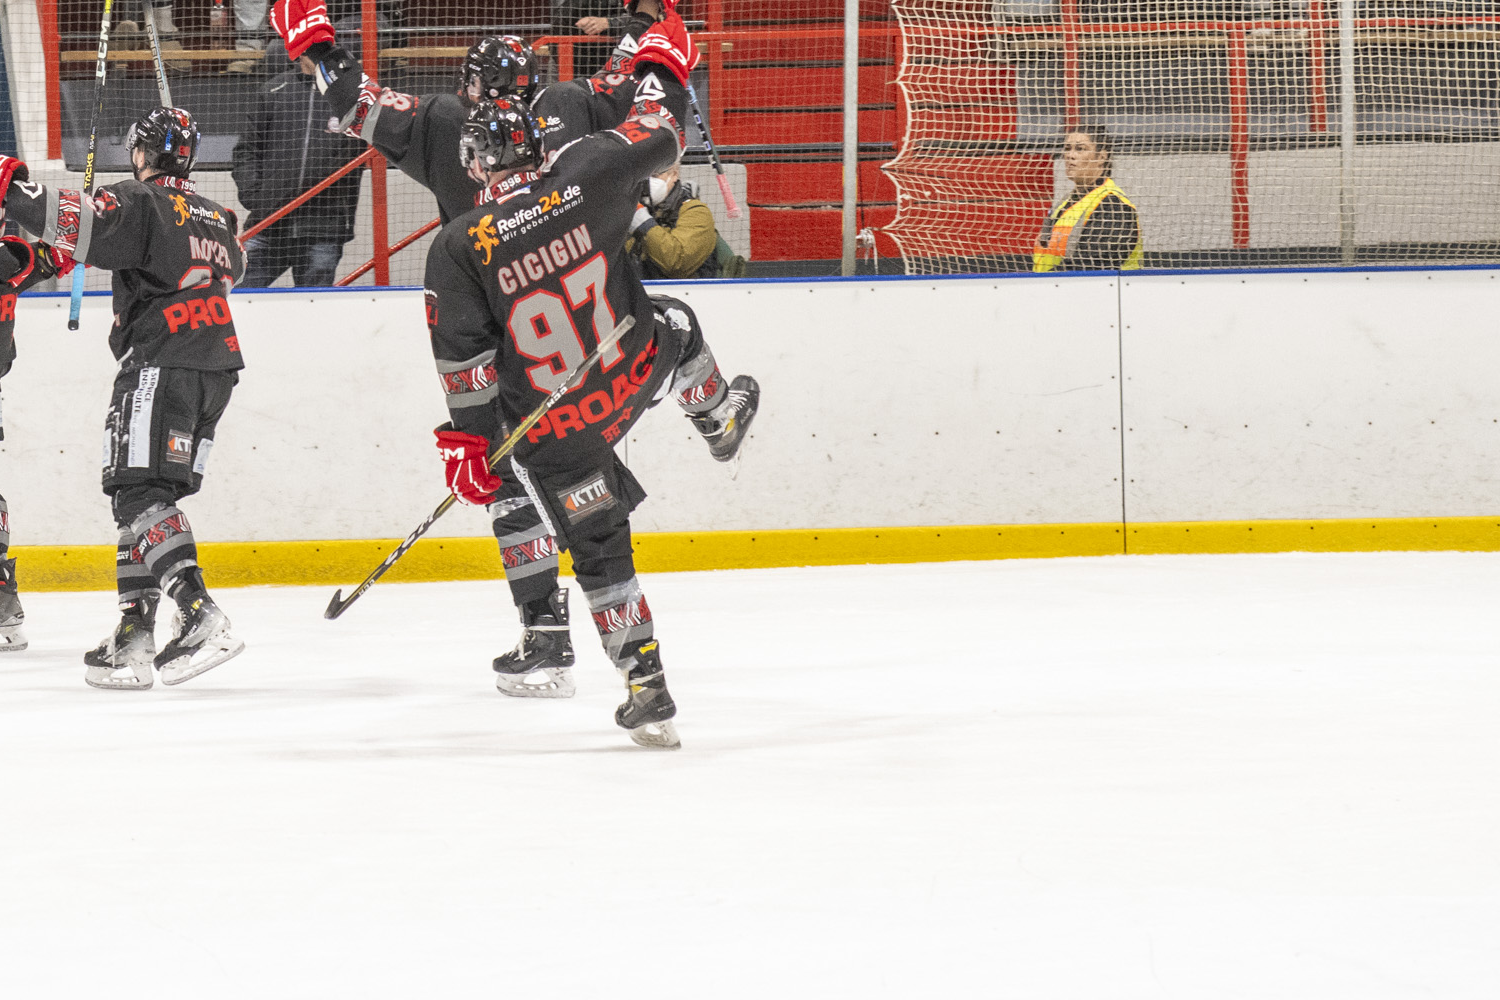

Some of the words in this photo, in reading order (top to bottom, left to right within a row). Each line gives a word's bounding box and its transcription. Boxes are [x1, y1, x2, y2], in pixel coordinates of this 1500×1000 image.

[95, 19, 111, 86] CCM
[83, 152, 95, 190] TACKS
[497, 174, 522, 193] 1996
[496, 184, 582, 235] Reifen24.de
[501, 230, 518, 243] Wir
[521, 214, 550, 236] geben
[552, 195, 585, 217] Gummi!
[498, 223, 594, 295] CICIGIN
[506, 250, 626, 396] 97
[174, 437, 192, 453] KT
[569, 478, 609, 508] KTM
